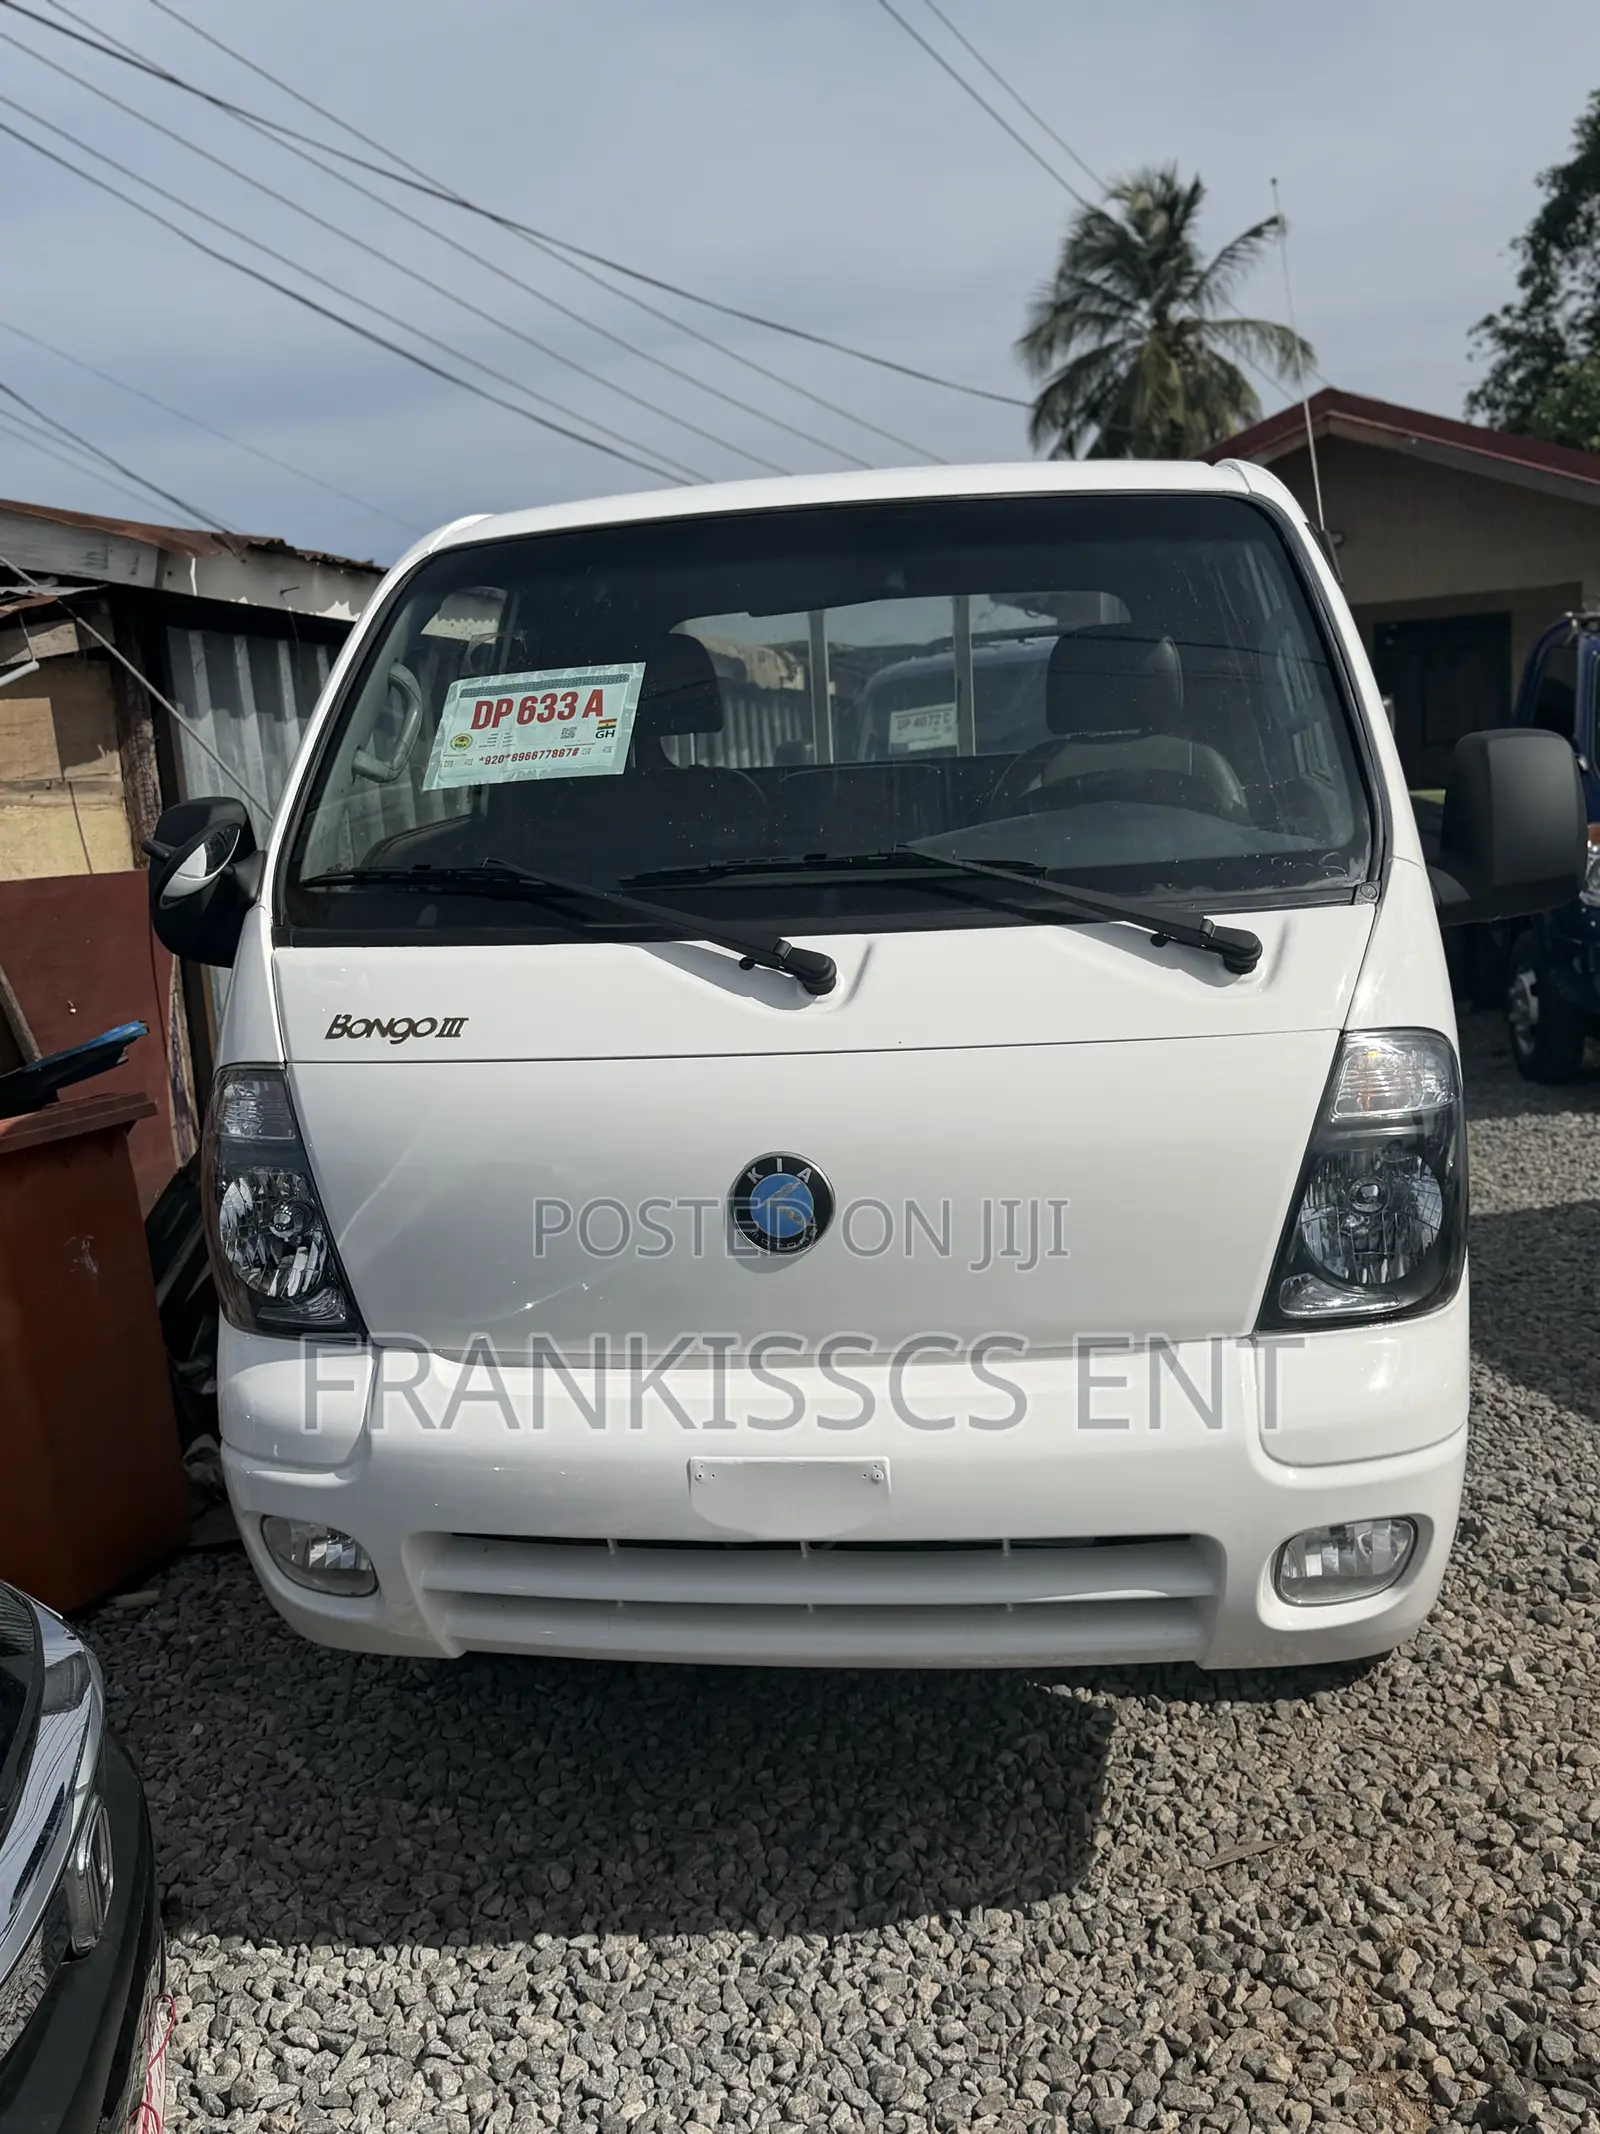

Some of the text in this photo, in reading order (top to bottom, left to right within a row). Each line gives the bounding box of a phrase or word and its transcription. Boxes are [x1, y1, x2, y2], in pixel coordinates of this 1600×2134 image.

[470, 689, 604, 730] DP 633 A
[595, 729, 616, 739] GH
[435, 1017, 470, 1038] III
[746, 1157, 812, 1185] KIA
